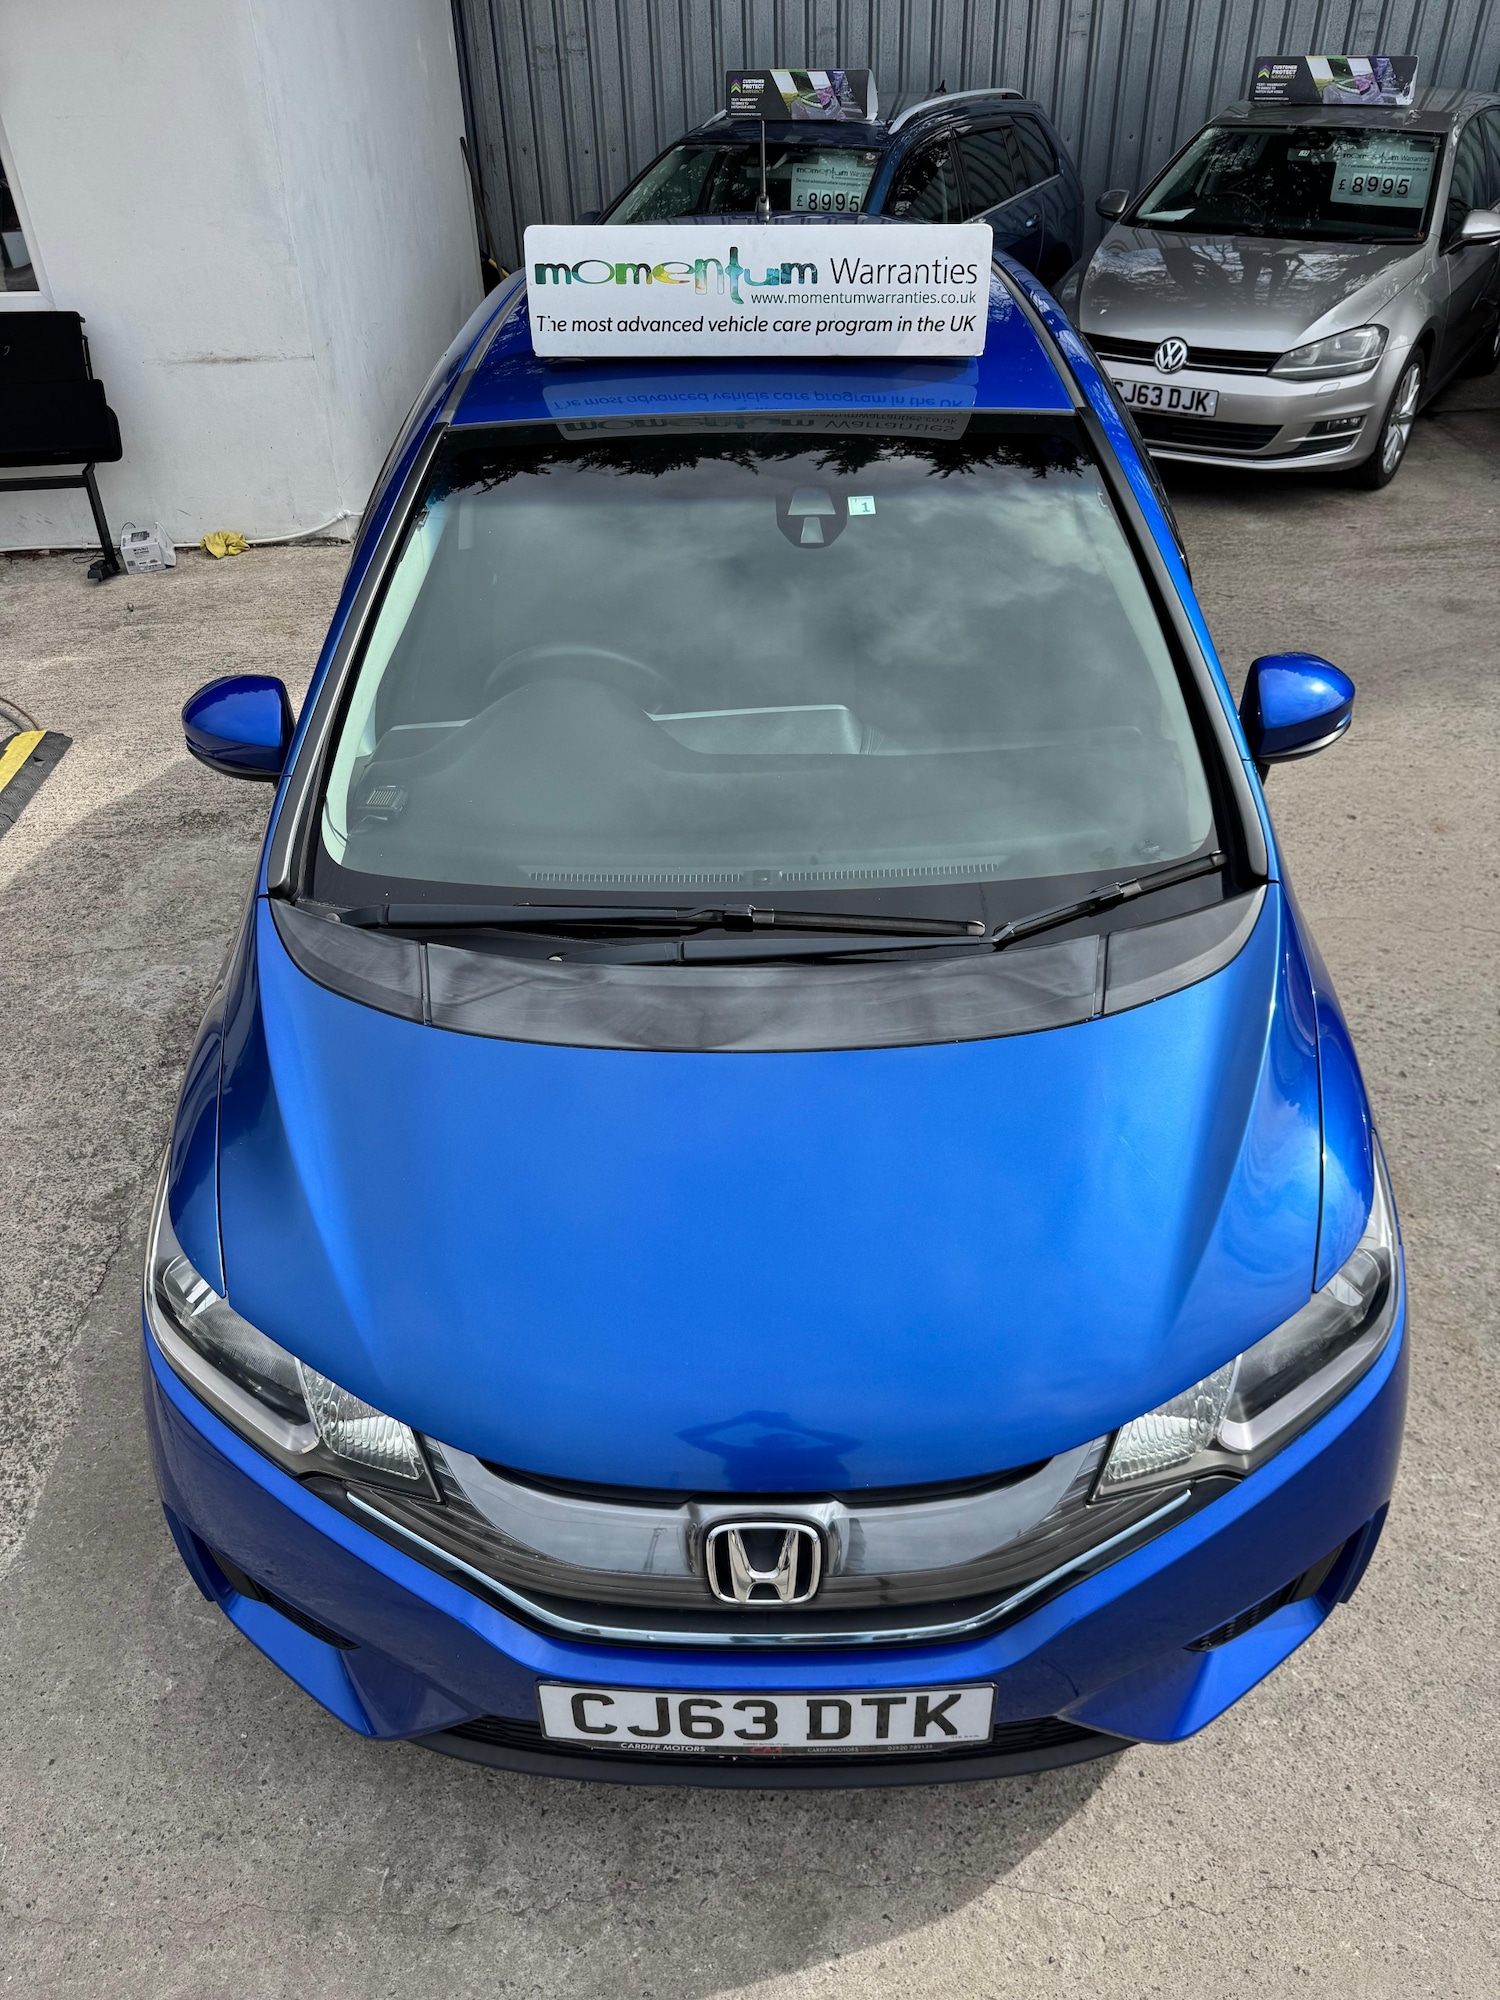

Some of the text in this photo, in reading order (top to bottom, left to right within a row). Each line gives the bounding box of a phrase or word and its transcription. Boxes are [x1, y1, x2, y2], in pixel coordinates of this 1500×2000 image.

[1338, 176, 1410, 195] £ 8995
[796, 192, 860, 213] £ 8995
[534, 246, 978, 304] momentum Warranties
[751, 291, 976, 304] www.momentumwarranties.co.uk
[571, 317, 613, 332] most
[617, 316, 704, 332] advanced
[708, 315, 768, 332] vehicle
[773, 319, 811, 332] care
[815, 319, 893, 335] program
[897, 316, 911, 332] in
[917, 316, 945, 332] the
[950, 316, 977, 332] UK
[1168, 388, 1210, 412] DJK
[861, 502, 870, 512] 1
[570, 1692, 962, 1740] CJ63 DTK
[620, 1742, 660, 1751] CARDIFF
[662, 1744, 706, 1753] MOTORS
